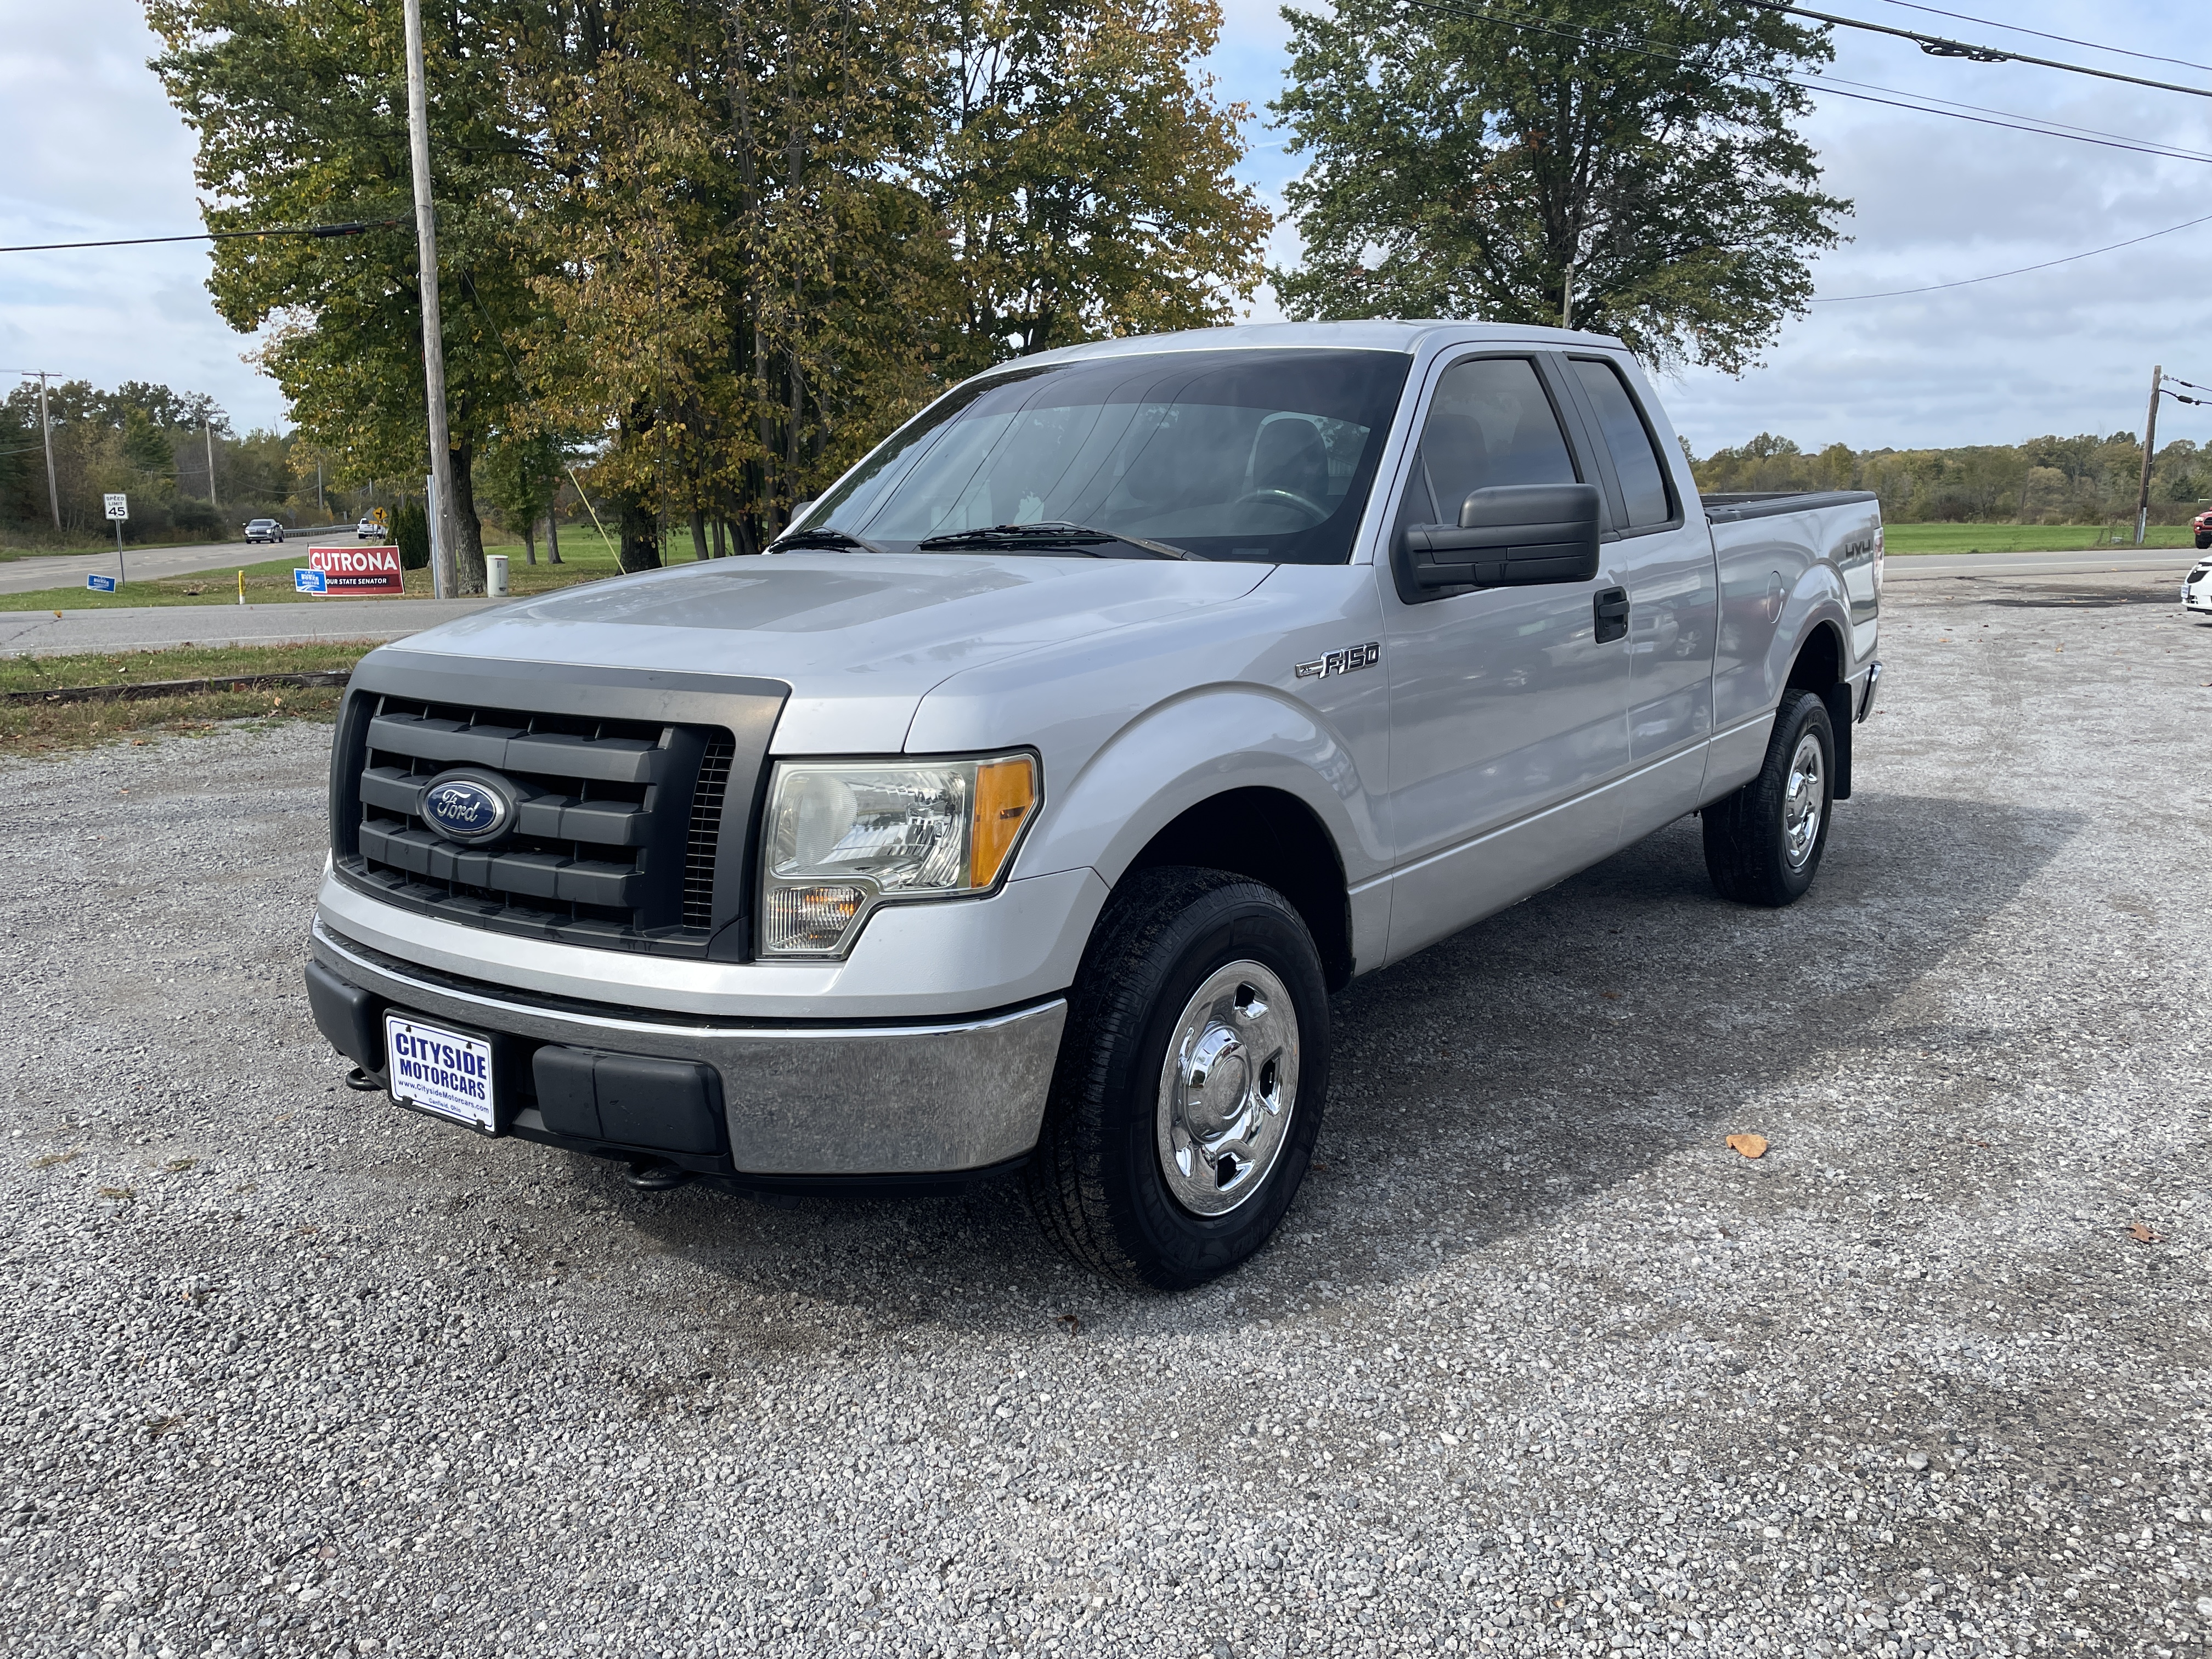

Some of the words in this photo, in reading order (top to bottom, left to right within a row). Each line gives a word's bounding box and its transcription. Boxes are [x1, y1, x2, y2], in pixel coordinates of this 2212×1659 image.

[108, 507, 125, 516] 45
[311, 551, 398, 571] CUTRONA
[437, 789, 481, 822] Ford
[395, 1032, 487, 1080] CITYSIDE
[398, 1079, 489, 1114] www.CitysideMotorcars.com
[399, 1058, 486, 1101] MOTORCARS
